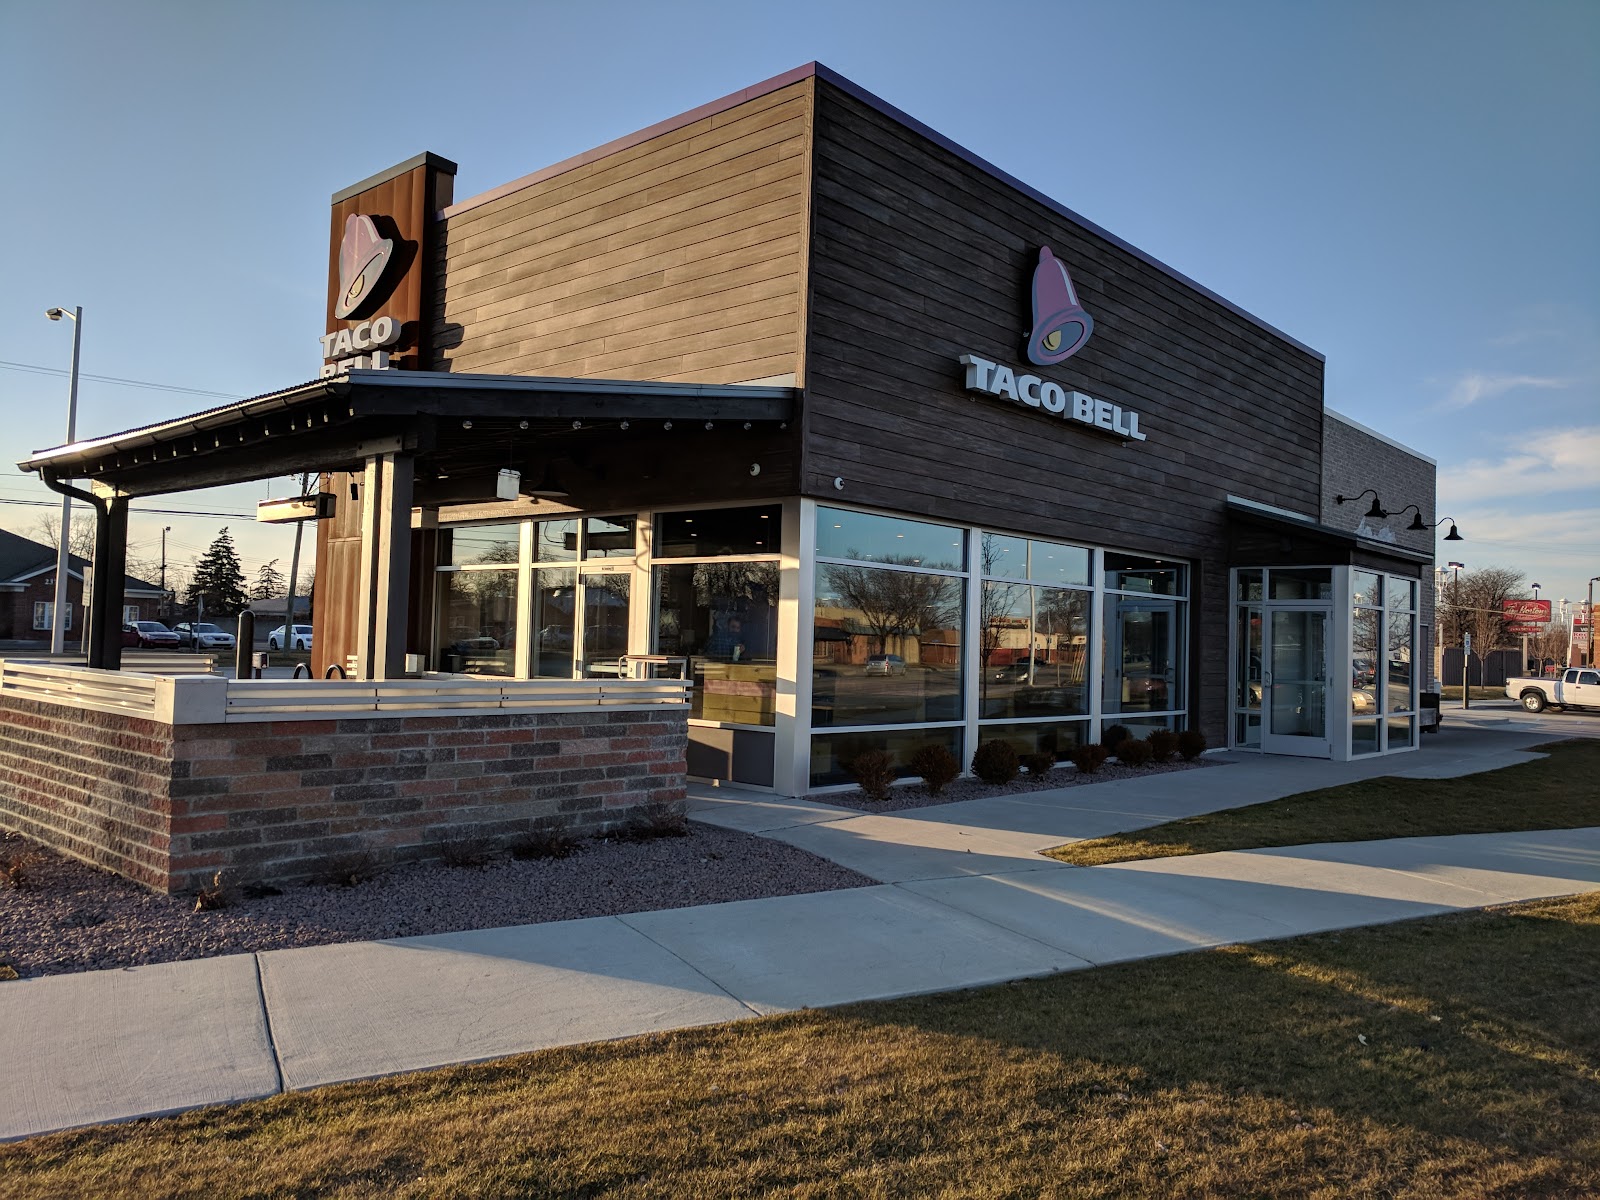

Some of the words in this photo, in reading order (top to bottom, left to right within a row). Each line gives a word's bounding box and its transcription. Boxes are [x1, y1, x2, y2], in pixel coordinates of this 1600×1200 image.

[319, 316, 396, 359] TACO
[960, 354, 1066, 414] TACO
[1069, 390, 1147, 441] BELL
